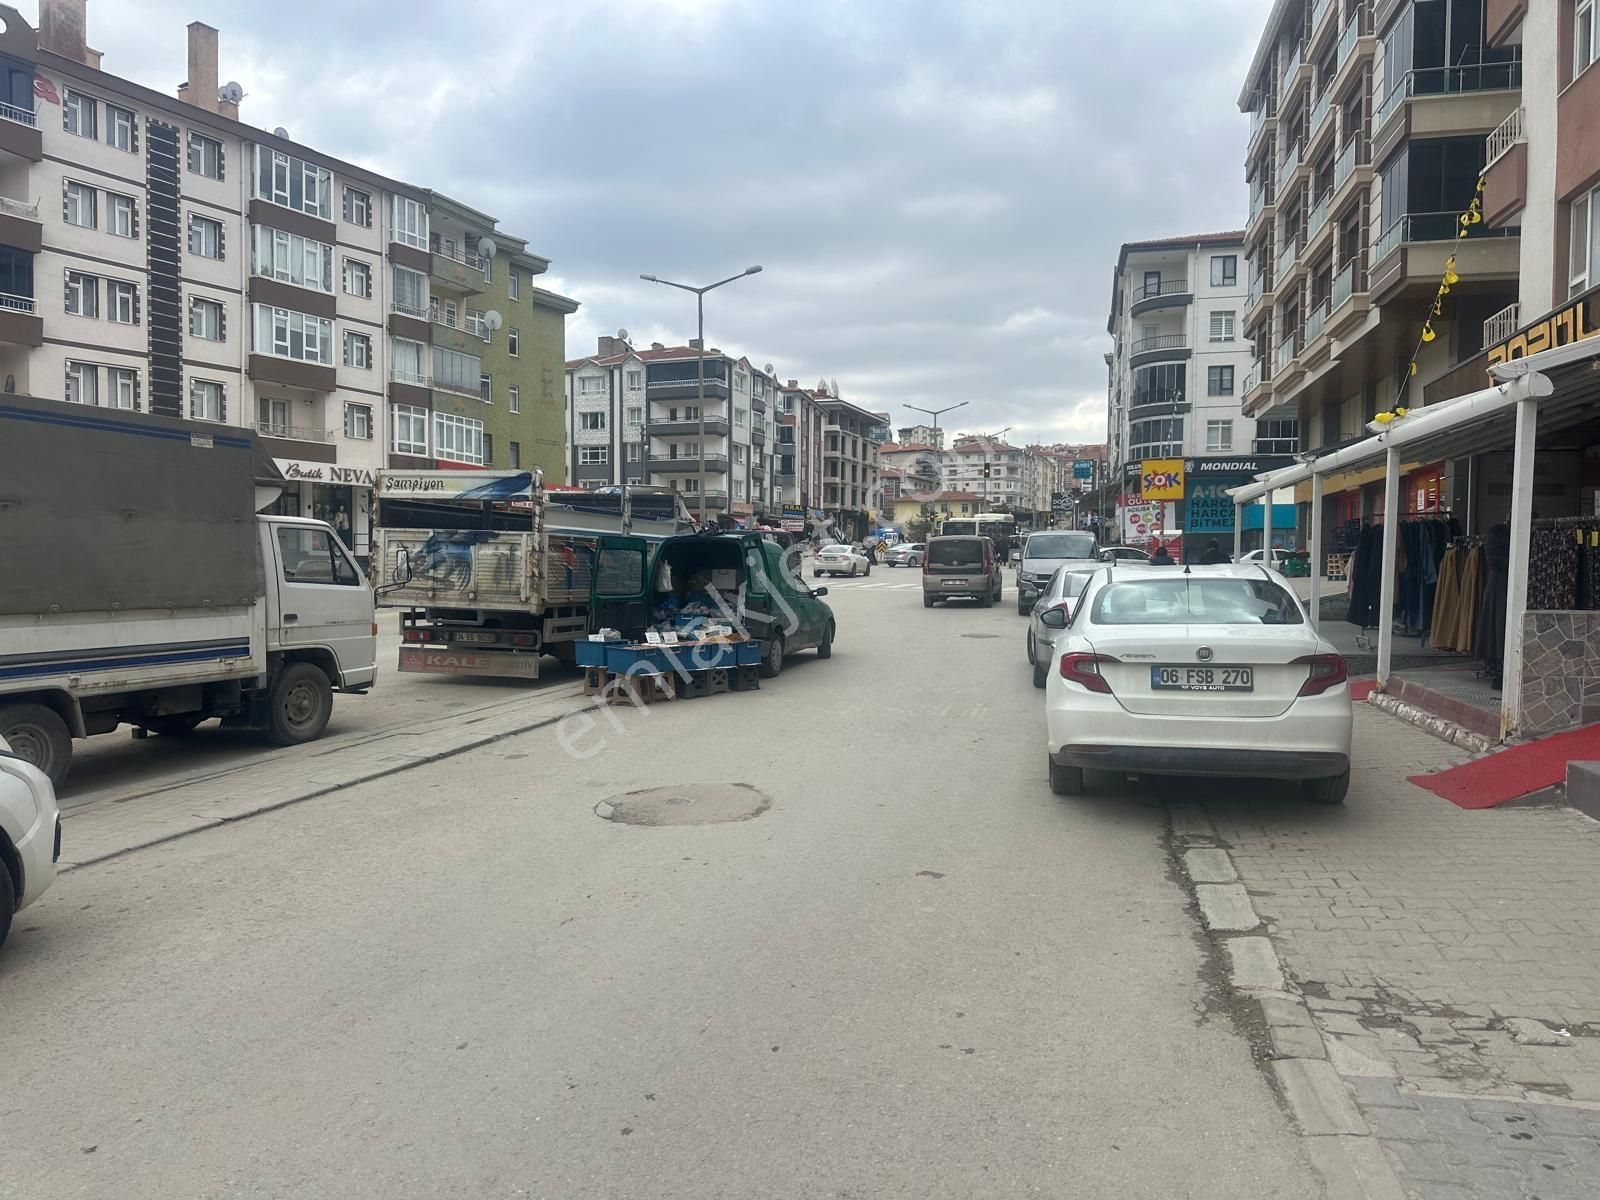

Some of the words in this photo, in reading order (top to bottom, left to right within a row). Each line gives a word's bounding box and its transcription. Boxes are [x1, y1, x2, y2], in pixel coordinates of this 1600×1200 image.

[285, 462, 323, 479] Butik
[329, 467, 373, 484] NEVA
[1200, 462, 1258, 471] MONDIAL
[385, 476, 444, 491] Şampiyon
[1143, 471, 1182, 492] ŞOK
[426, 655, 489, 668] KALE
[1160, 669, 1179, 684] 06
[1186, 669, 1214, 684] FSB
[1221, 670, 1250, 685] 270
